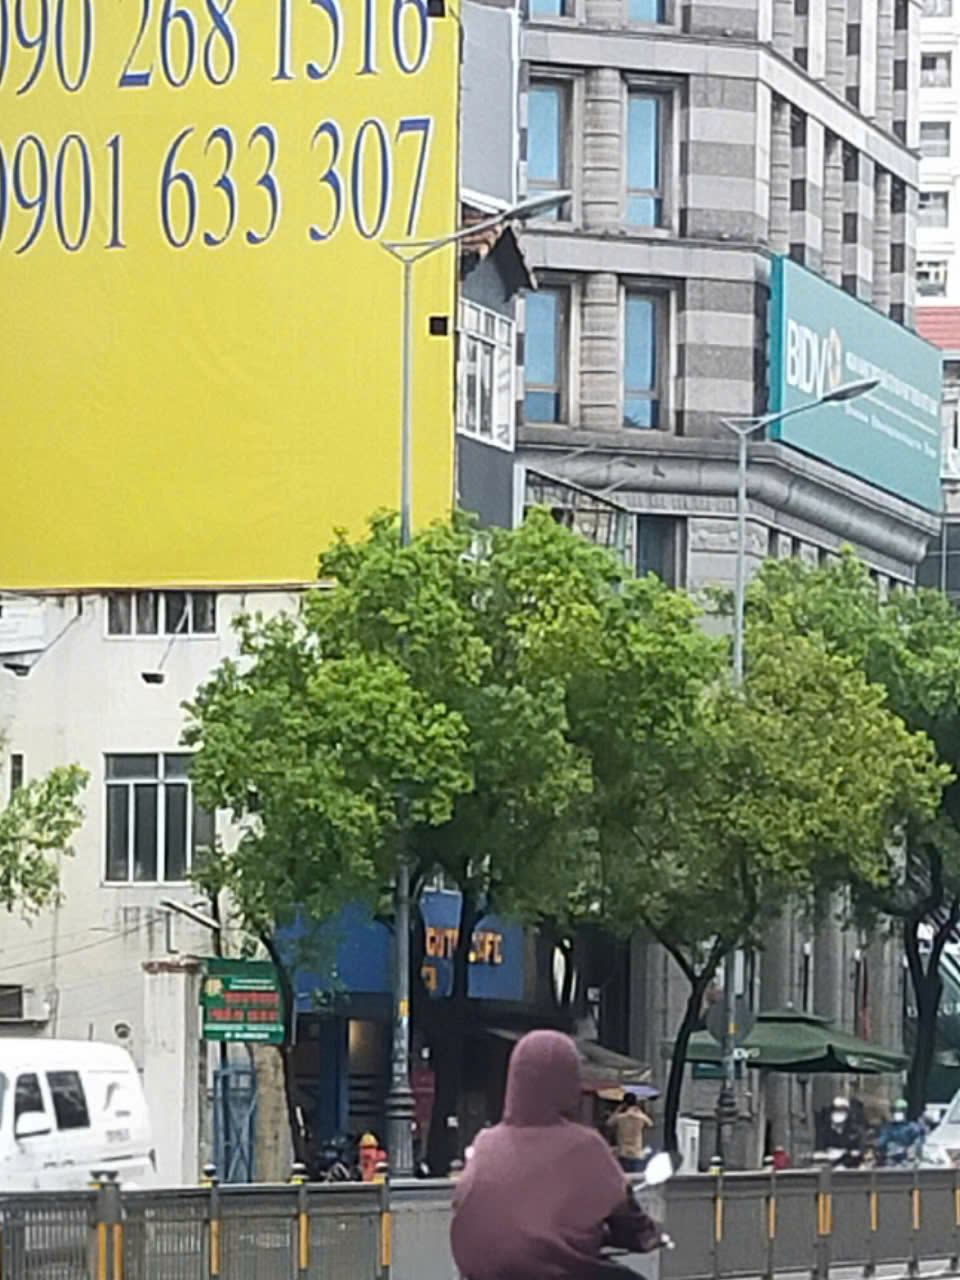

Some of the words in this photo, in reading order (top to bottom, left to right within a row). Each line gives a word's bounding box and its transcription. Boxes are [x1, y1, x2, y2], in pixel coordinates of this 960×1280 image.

[118, 0, 236, 88] 268
[272, 0, 430, 81] 1516
[160, 124, 281, 249] 633
[309, 117, 432, 241] 307
